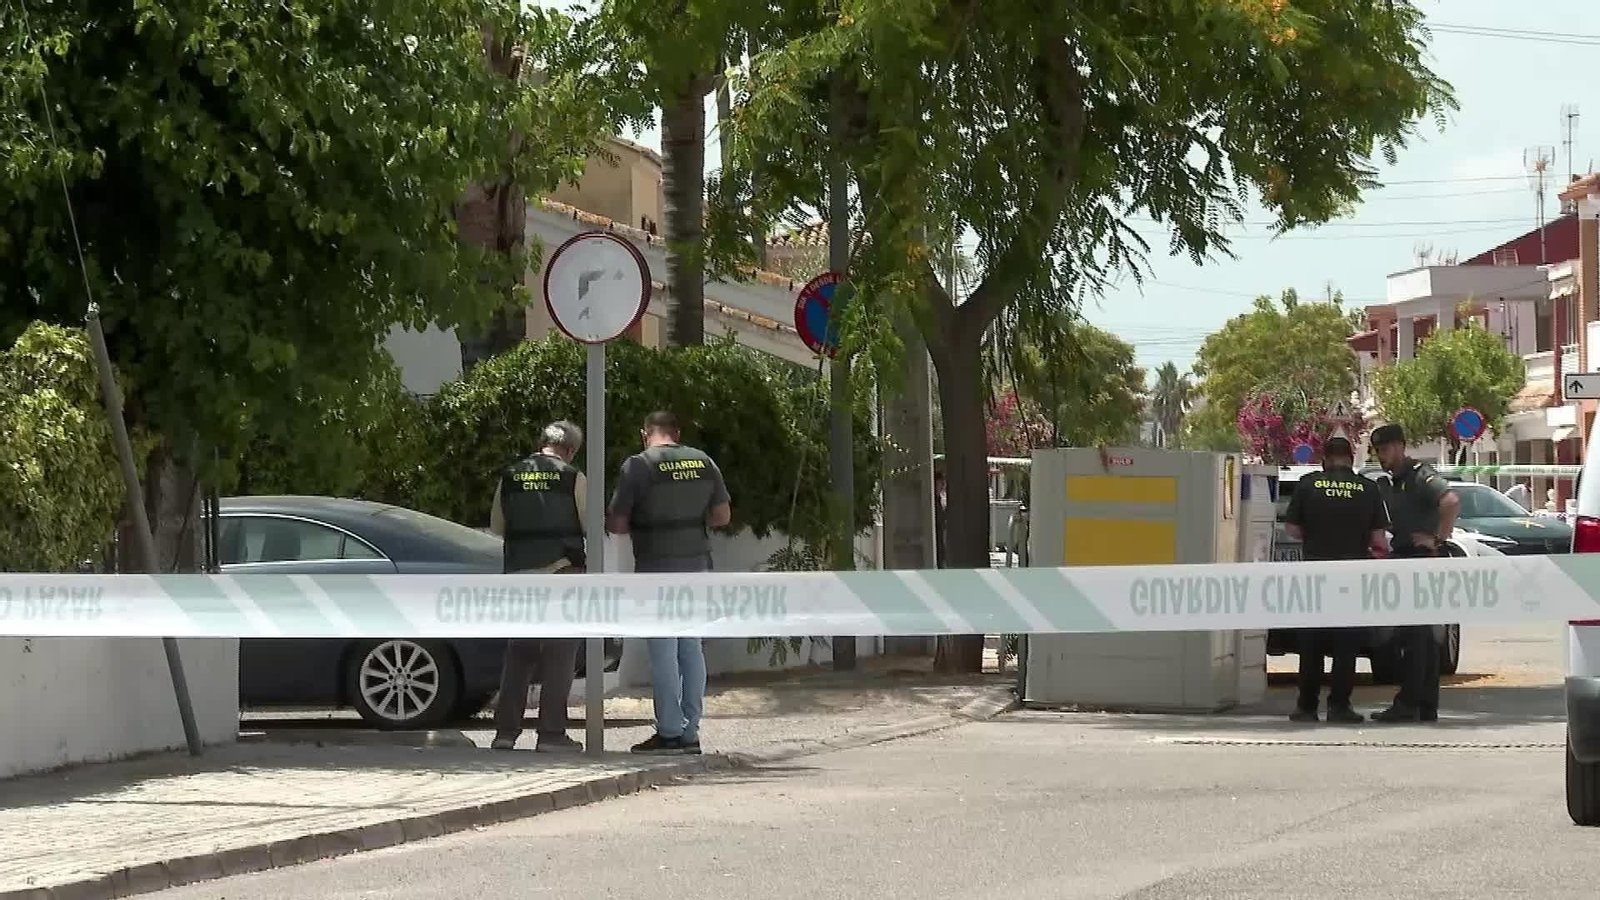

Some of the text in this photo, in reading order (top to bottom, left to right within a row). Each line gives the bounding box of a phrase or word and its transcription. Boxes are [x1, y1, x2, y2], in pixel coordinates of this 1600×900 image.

[659, 460, 706, 472] GUARDIA
[513, 471, 561, 482] GUARDIA
[672, 470, 701, 480] CIVIL
[522, 481, 551, 491] CIVIL
[1314, 480, 1365, 492] GUARDIA
[1325, 488, 1353, 499] CIVIL
